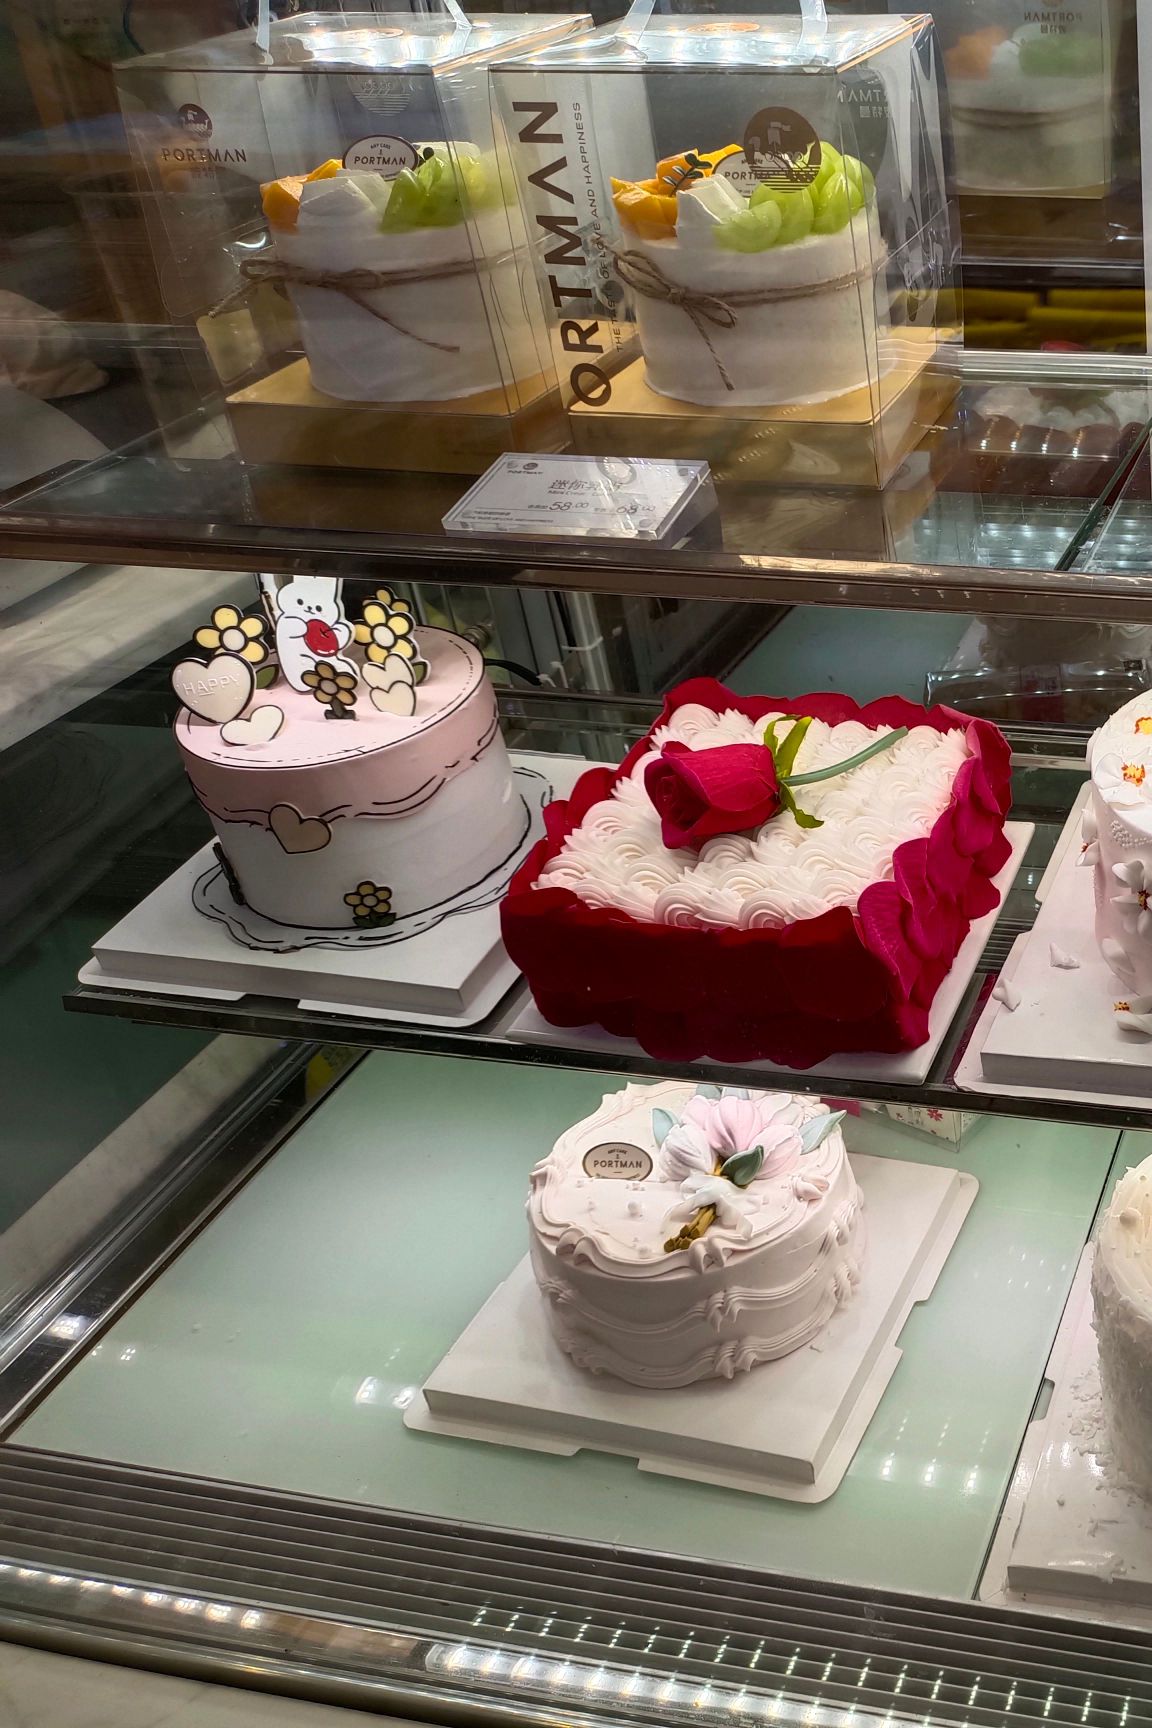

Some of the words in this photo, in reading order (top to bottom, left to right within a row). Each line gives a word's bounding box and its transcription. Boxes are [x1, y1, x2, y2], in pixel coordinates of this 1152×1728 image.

[572, 101, 594, 185] HAPPINESS
[161, 148, 247, 162] PORTMAN
[354, 156, 406, 165] PORTMAN
[586, 188, 600, 219] AND
[600, 261, 610, 279] OF
[614, 327, 624, 353] THE
[593, 1160, 643, 1169] PORTMAN
